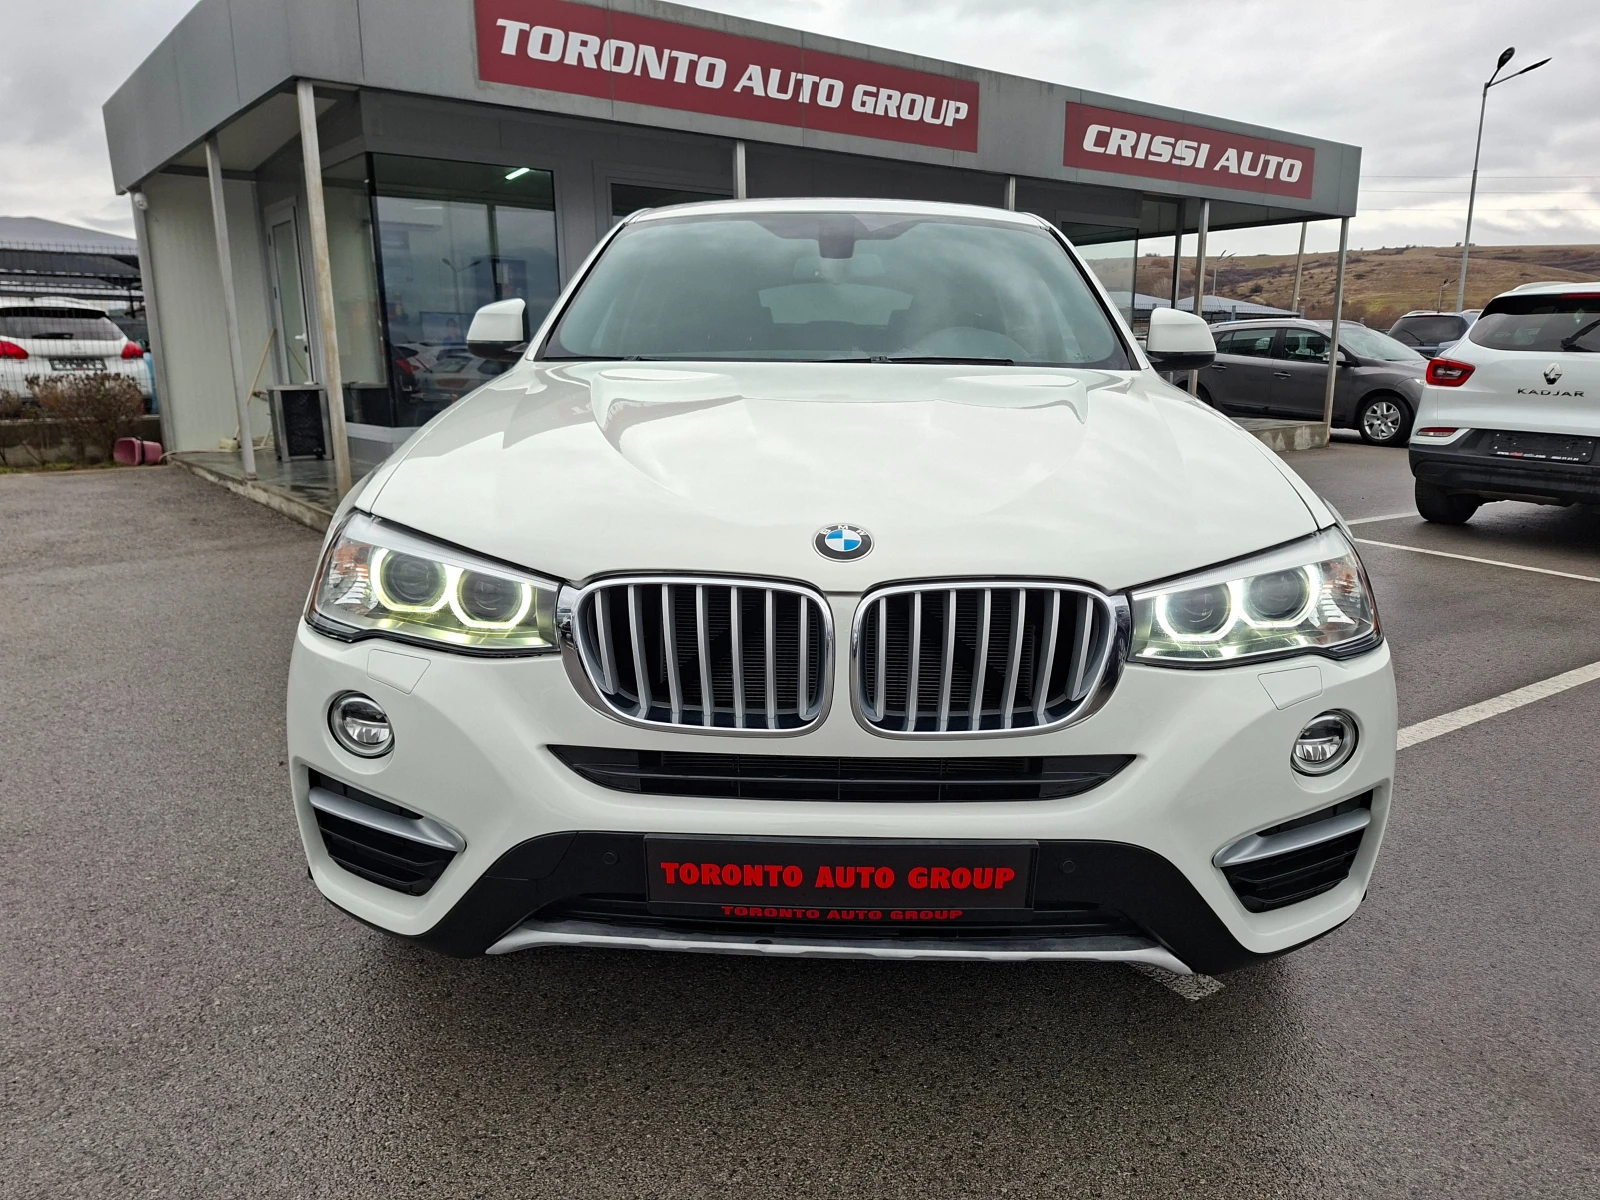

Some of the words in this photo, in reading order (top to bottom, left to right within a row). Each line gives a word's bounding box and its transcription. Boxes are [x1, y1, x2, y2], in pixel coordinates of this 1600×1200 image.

[496, 18, 727, 89] TORONTO
[733, 64, 845, 108] AUTO
[851, 84, 969, 127] GROUP
[1082, 123, 1211, 169] CRISSI
[1213, 148, 1303, 183] AUTO
[1517, 387, 1585, 398] KADJAR
[660, 862, 804, 888] TORONTO
[815, 866, 895, 889] AUTO
[907, 867, 1016, 890] GROUP
[721, 905, 820, 919] TORONTO
[826, 909, 883, 920] AUTO
[889, 909, 964, 920] GROUP
